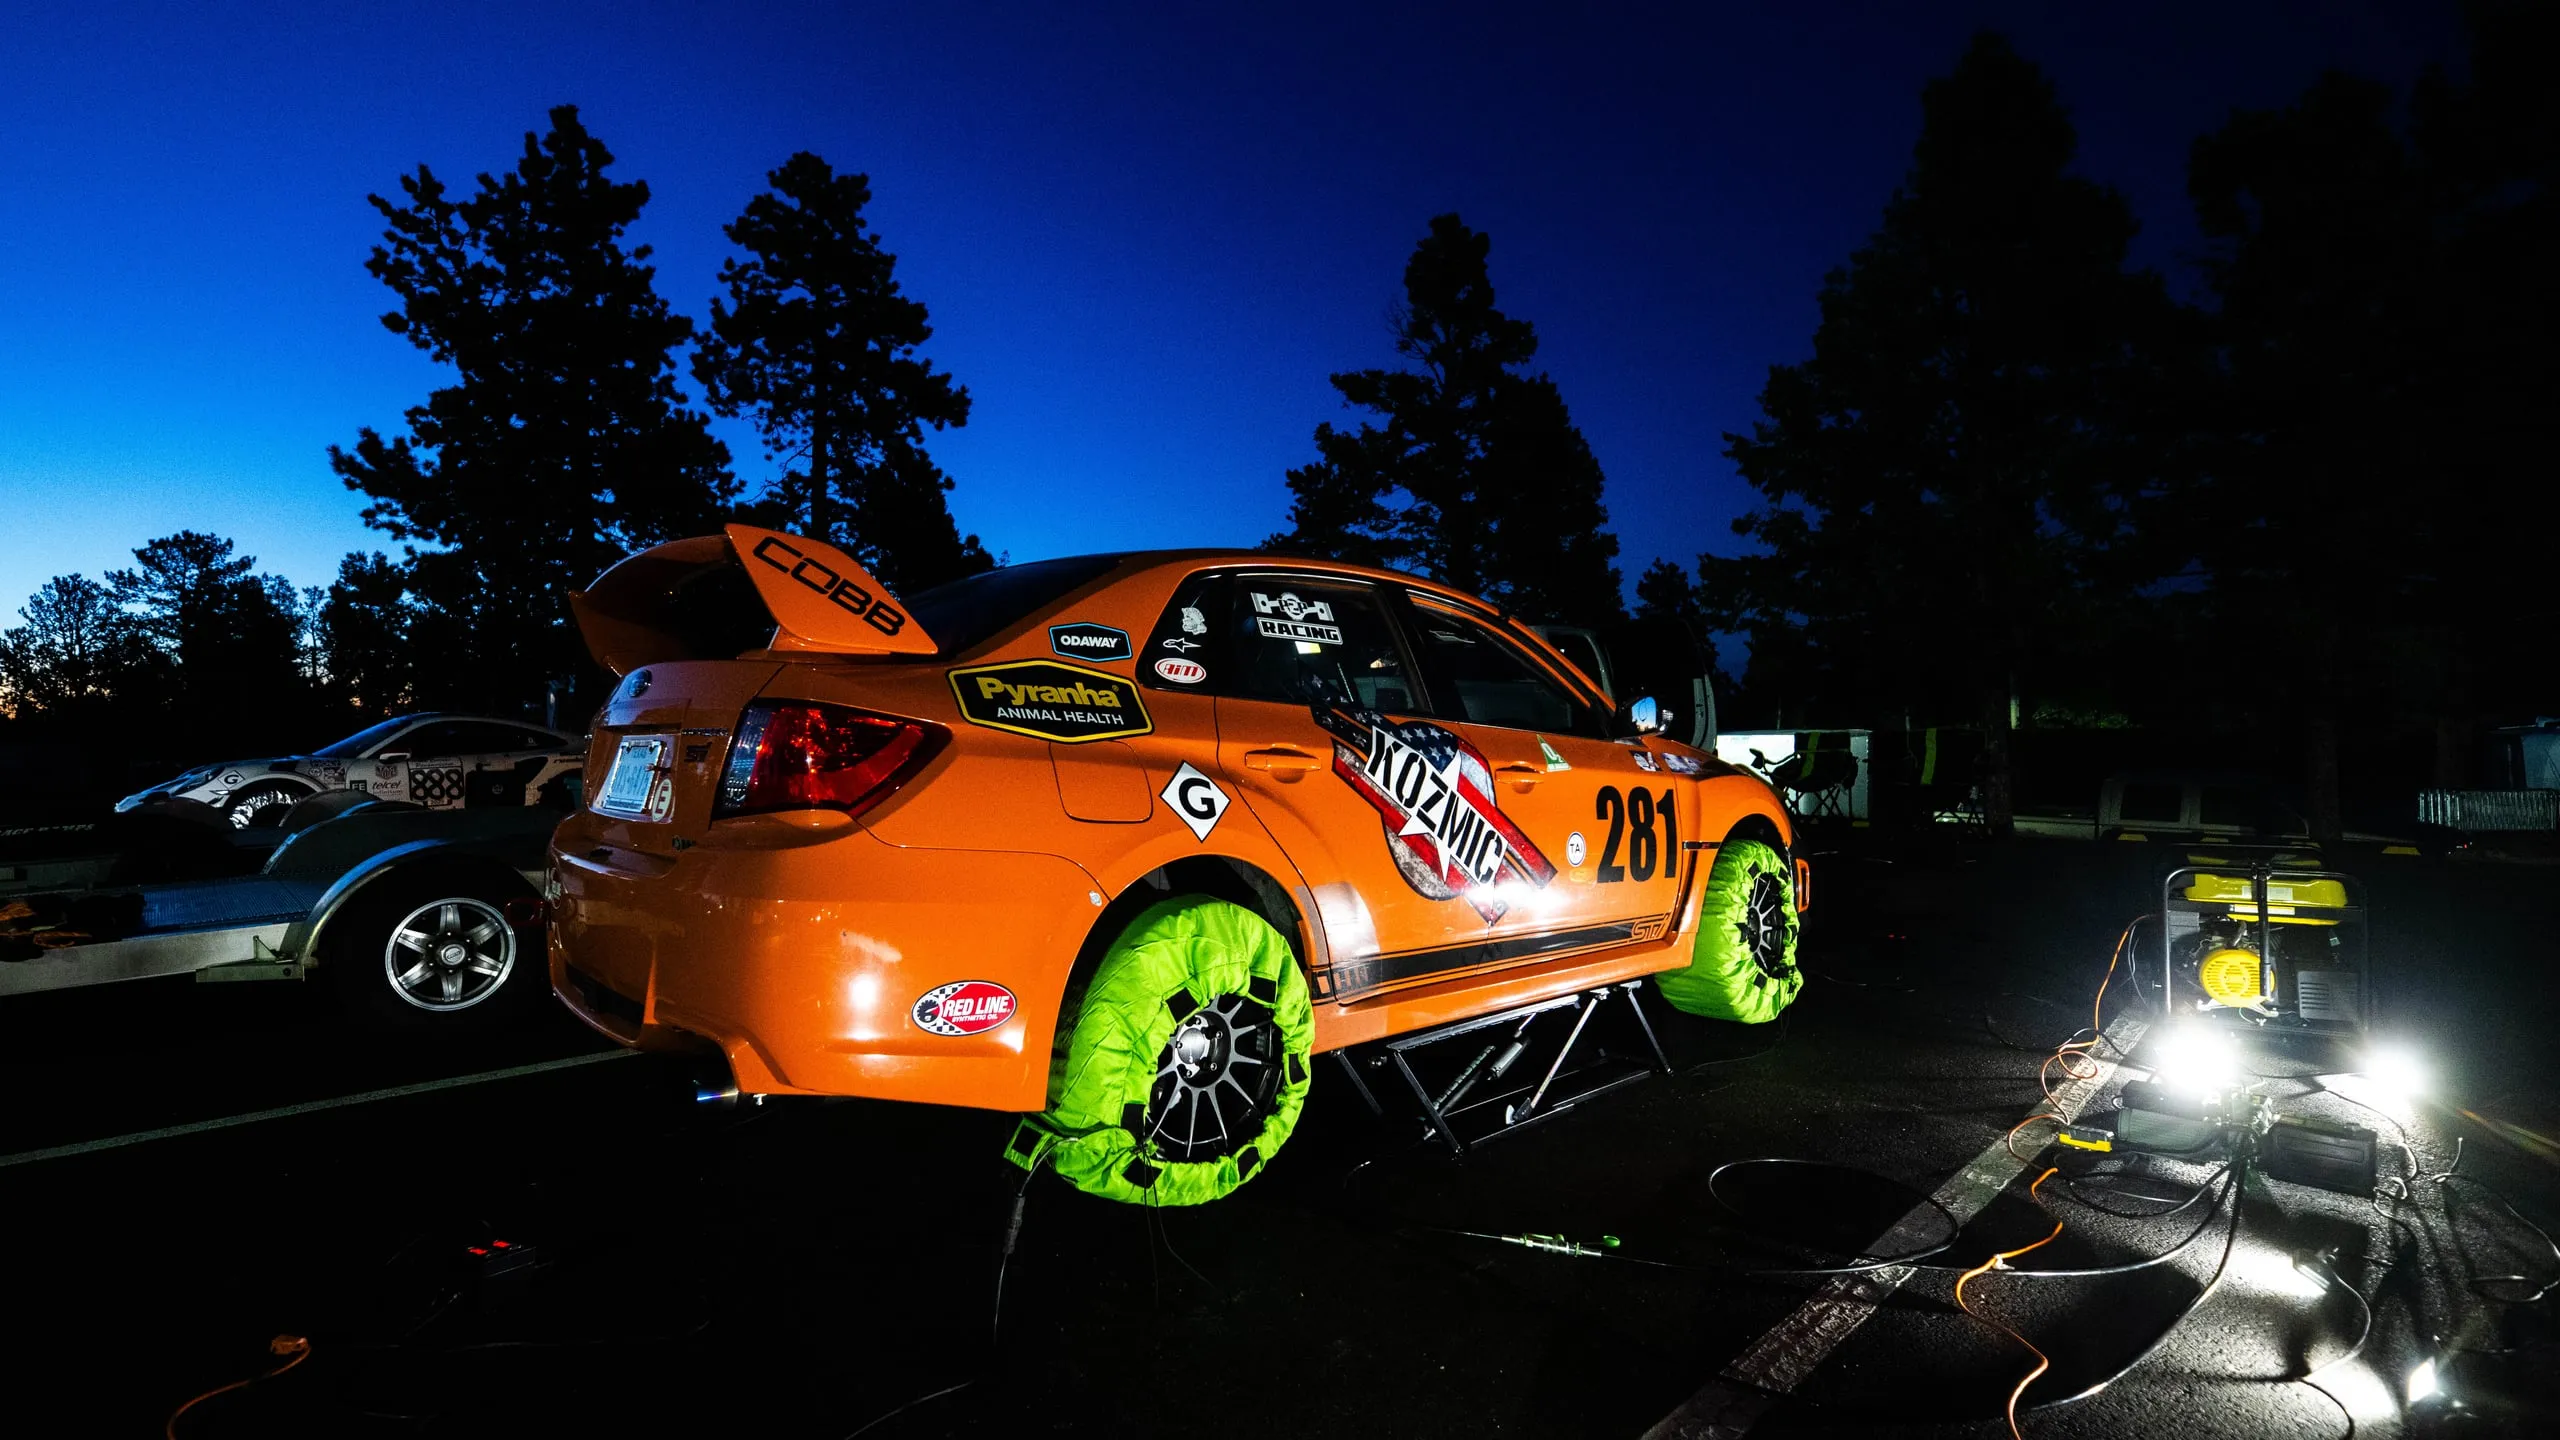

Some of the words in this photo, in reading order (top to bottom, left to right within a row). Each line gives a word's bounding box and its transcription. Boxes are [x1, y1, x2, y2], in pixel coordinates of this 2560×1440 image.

[753, 536, 906, 636] COBB
[1060, 635, 1118, 648] ODAWAY
[1260, 620, 1339, 641] RACING
[976, 677, 1121, 708] Pyranha
[997, 706, 1061, 726] ANIMAL
[1065, 711, 1124, 725] HEALTH
[224, 774, 239, 785] G
[373, 780, 401, 789] telcel
[411, 768, 464, 800] 888
[655, 785, 669, 814] E
[1179, 777, 1217, 820] G
[1367, 732, 1503, 885] KOZMIC
[1596, 785, 1677, 883] 281
[943, 998, 975, 1018] RED
[975, 995, 1010, 1016] LINE
